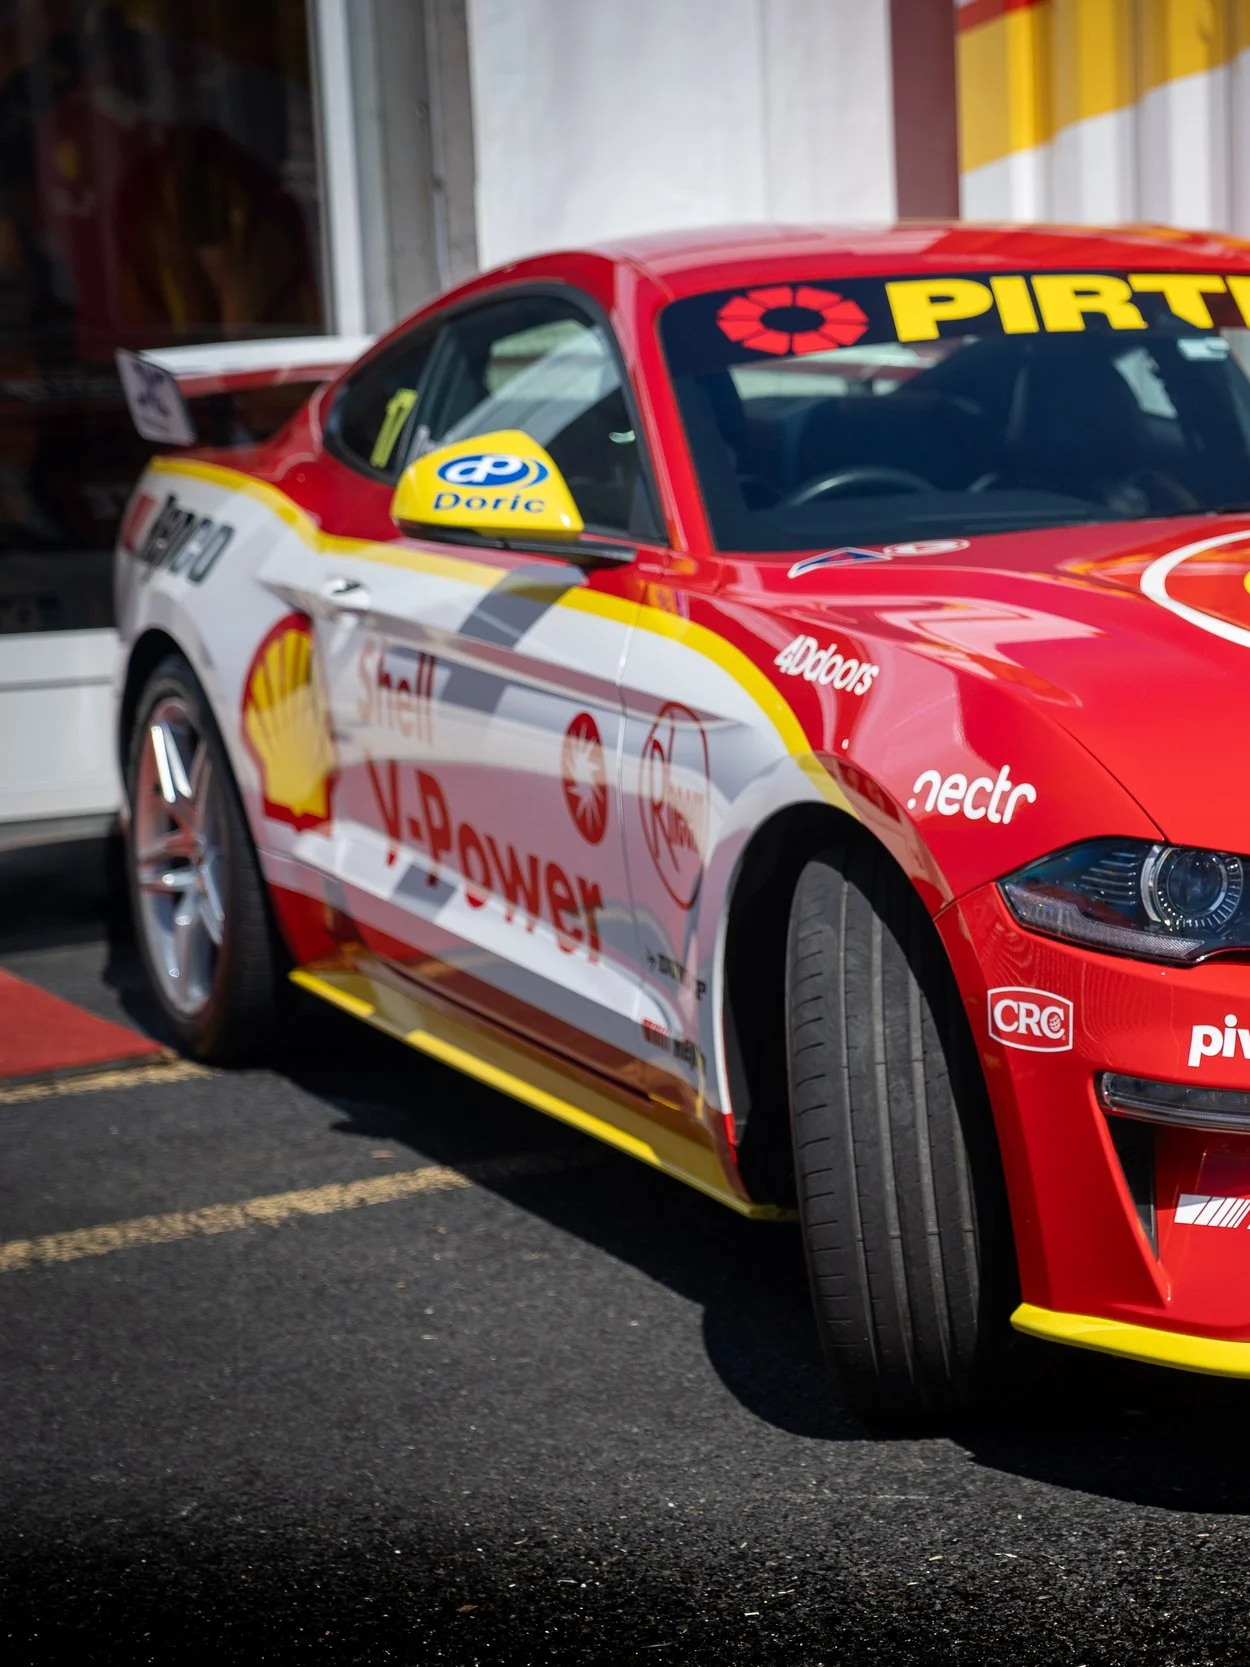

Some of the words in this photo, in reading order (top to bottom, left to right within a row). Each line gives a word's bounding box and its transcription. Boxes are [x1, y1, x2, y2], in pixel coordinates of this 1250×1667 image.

[433, 492, 545, 513] Doric
[774, 634, 880, 696] 4Ddoors
[365, 750, 604, 965] V-Power
[993, 998, 1066, 1040] CRC
